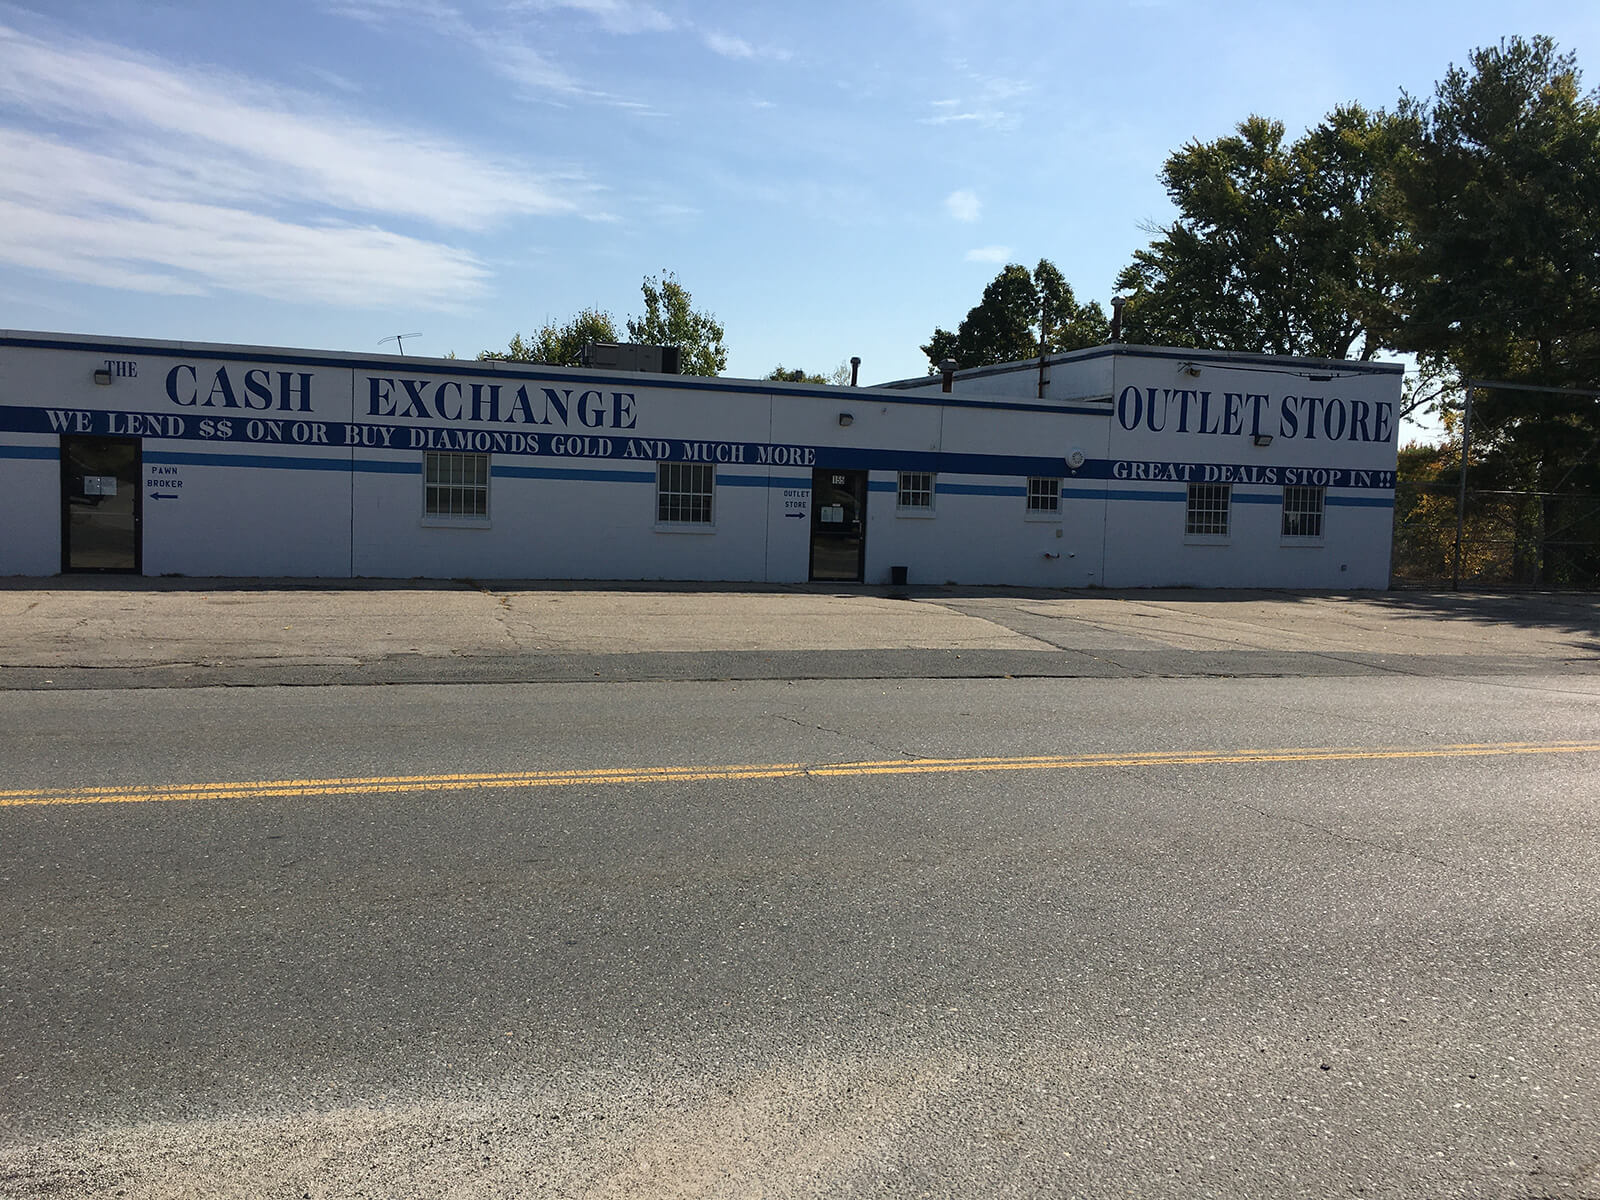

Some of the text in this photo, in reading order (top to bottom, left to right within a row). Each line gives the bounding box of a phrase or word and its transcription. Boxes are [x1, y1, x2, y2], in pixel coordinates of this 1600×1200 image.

[104, 360, 638, 429] THE CASH EXCHANGE
[1117, 385, 1393, 443] OUTLET STORE
[45, 410, 817, 466] WE LEND $$ ON OR BUY DIAMONDS GOLD AND MUCH MORE
[146, 479, 183, 489] BROKER
[151, 466, 178, 475] PAWN
[1112, 460, 1196, 481] GREAT
[1203, 465, 1278, 484] DEALS
[1285, 468, 1343, 486] STOP
[1349, 470, 1374, 487] IN
[783, 490, 810, 498] OUTLET
